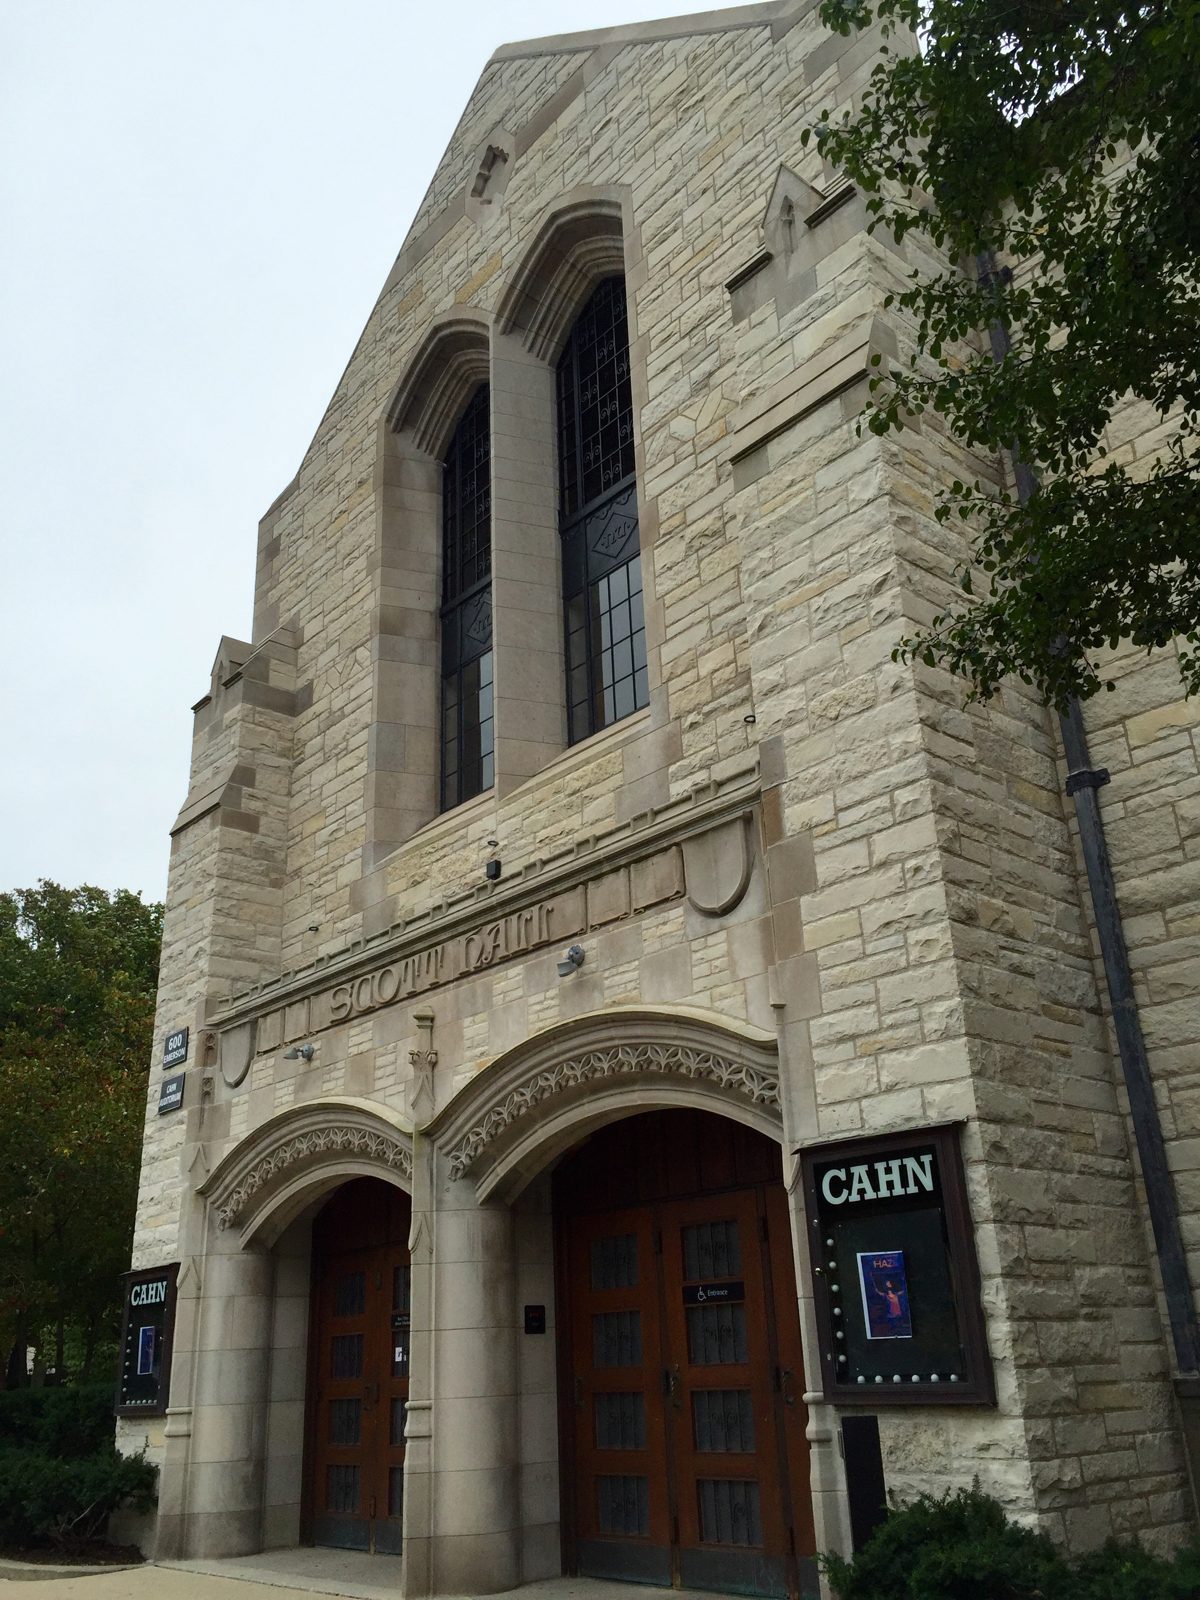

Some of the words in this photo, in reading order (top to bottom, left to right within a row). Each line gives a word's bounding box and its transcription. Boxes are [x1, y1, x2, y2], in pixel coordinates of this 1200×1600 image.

[329, 944, 445, 1025] SCOTT
[457, 902, 555, 977] HALL
[164, 1047, 186, 1063] EMERSON
[168, 1034, 182, 1050] 600
[821, 1154, 935, 1206] CAHN
[131, 1280, 166, 1306] CAHN
